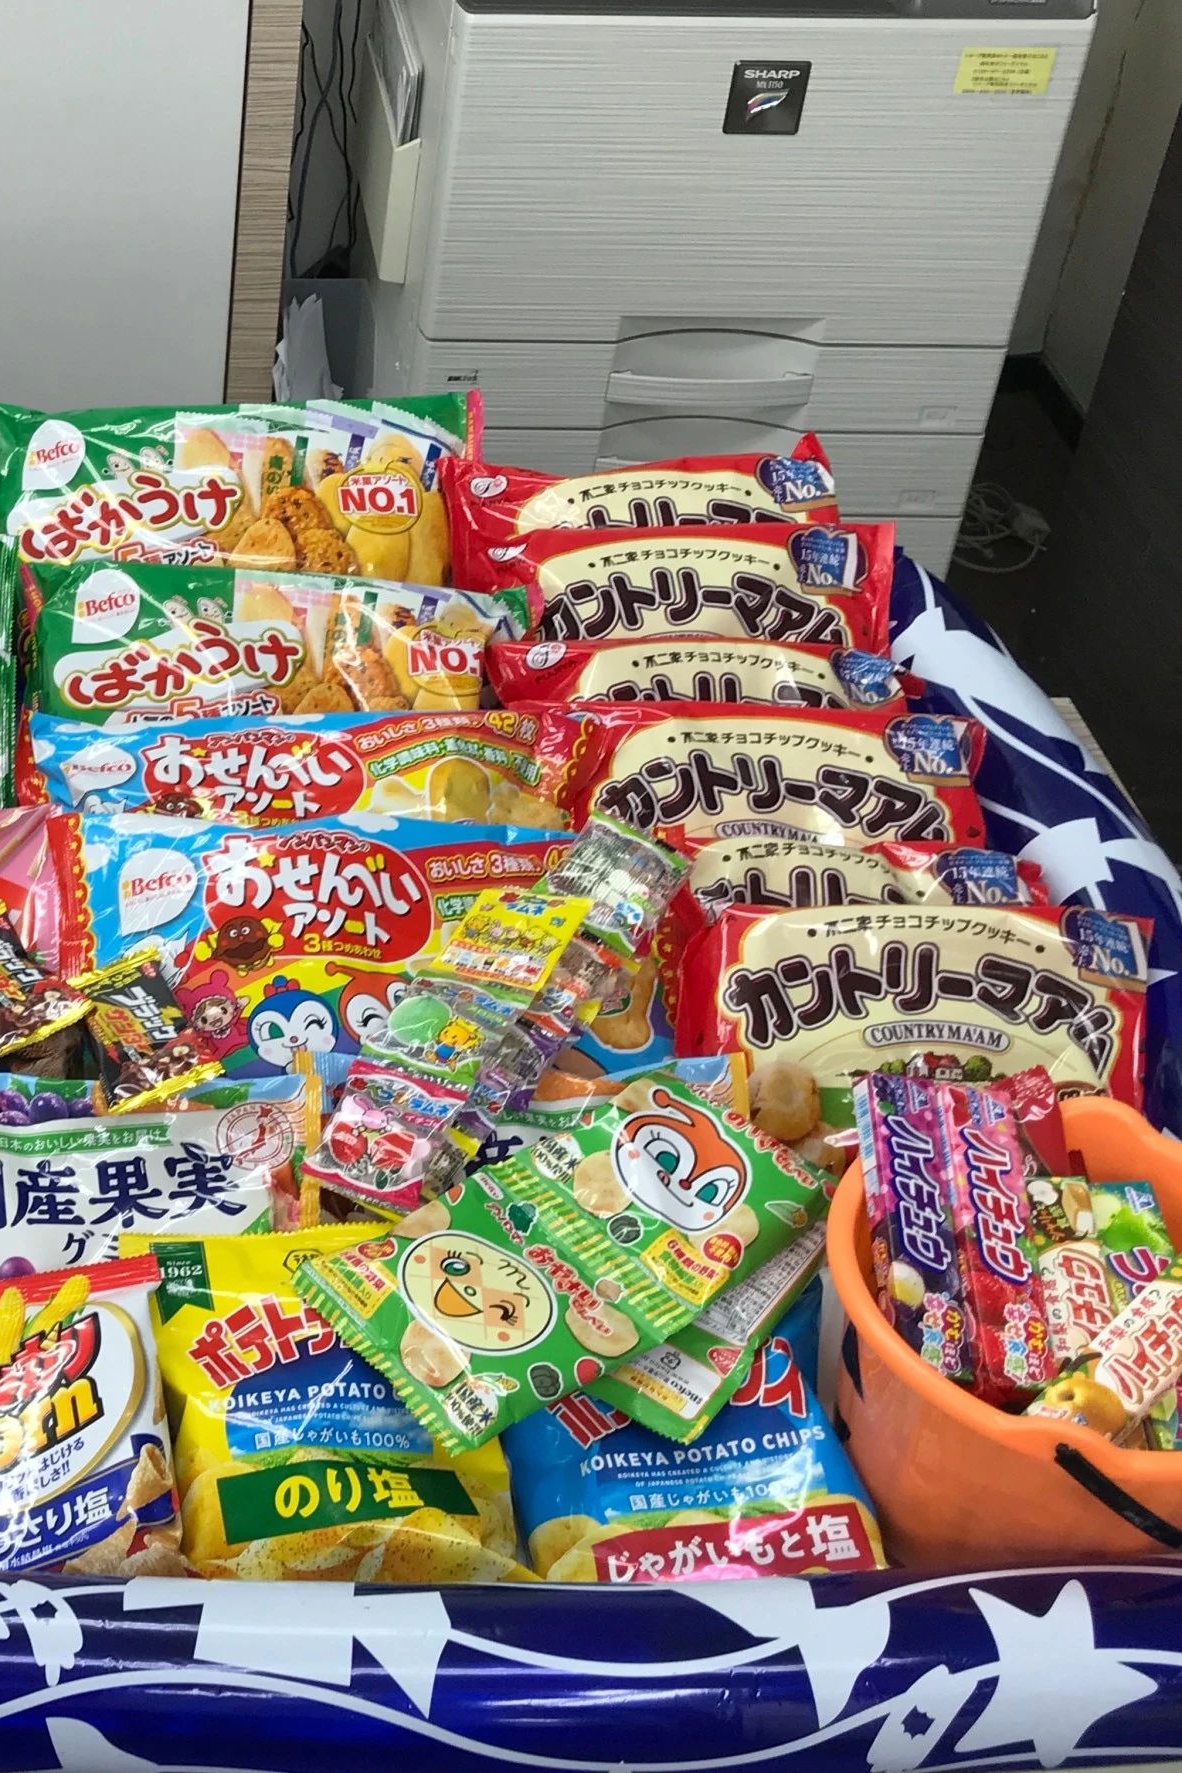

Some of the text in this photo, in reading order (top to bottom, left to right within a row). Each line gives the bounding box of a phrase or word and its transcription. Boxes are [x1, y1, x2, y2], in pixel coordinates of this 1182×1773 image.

[743, 69, 801, 79] SHARP
[340, 488, 416, 514] NO.1
[579, 478, 742, 502] 不二家チョコチップクッキー
[21, 475, 238, 560] ばかうけ
[601, 549, 770, 567] 不二家チョコチップクッキー
[85, 592, 136, 616] Befco
[536, 567, 851, 643] カントリーマアム
[68, 621, 300, 705] ばかうけ
[644, 652, 814, 672] 不二家チョコチップクッキー
[150, 737, 353, 790] おせんべい
[681, 732, 861, 757] 不二家チョコチップクッキー
[218, 785, 322, 818] アソート
[597, 749, 953, 843] カントリーマアム
[721, 822, 786, 839] COUNTRY
[131, 871, 193, 897] Befco
[208, 838, 422, 915] おせんべい
[283, 902, 391, 945] アソート
[824, 914, 1032, 946] 不二家チョコチップクッキー
[105, 1006, 156, 1056] サンダー
[110, 985, 179, 1041] ブラック
[723, 942, 1116, 1076] カントリーマアム
[870, 1024, 1004, 1050] COUNTRY MA'AM
[886, 1114, 952, 1274] ハイチュウ
[960, 1127, 1033, 1285] ハイチュウ
[160, 1265, 204, 1280] 1962
[1057, 1251, 1115, 1341] イチュウ
[307, 1382, 387, 1402] POTATO
[580, 1425, 826, 1478] KOIKEYA POTATO CHIPS
[274, 1466, 424, 1519] のり塩
[607, 1513, 861, 1583] じゃがいもと塩
